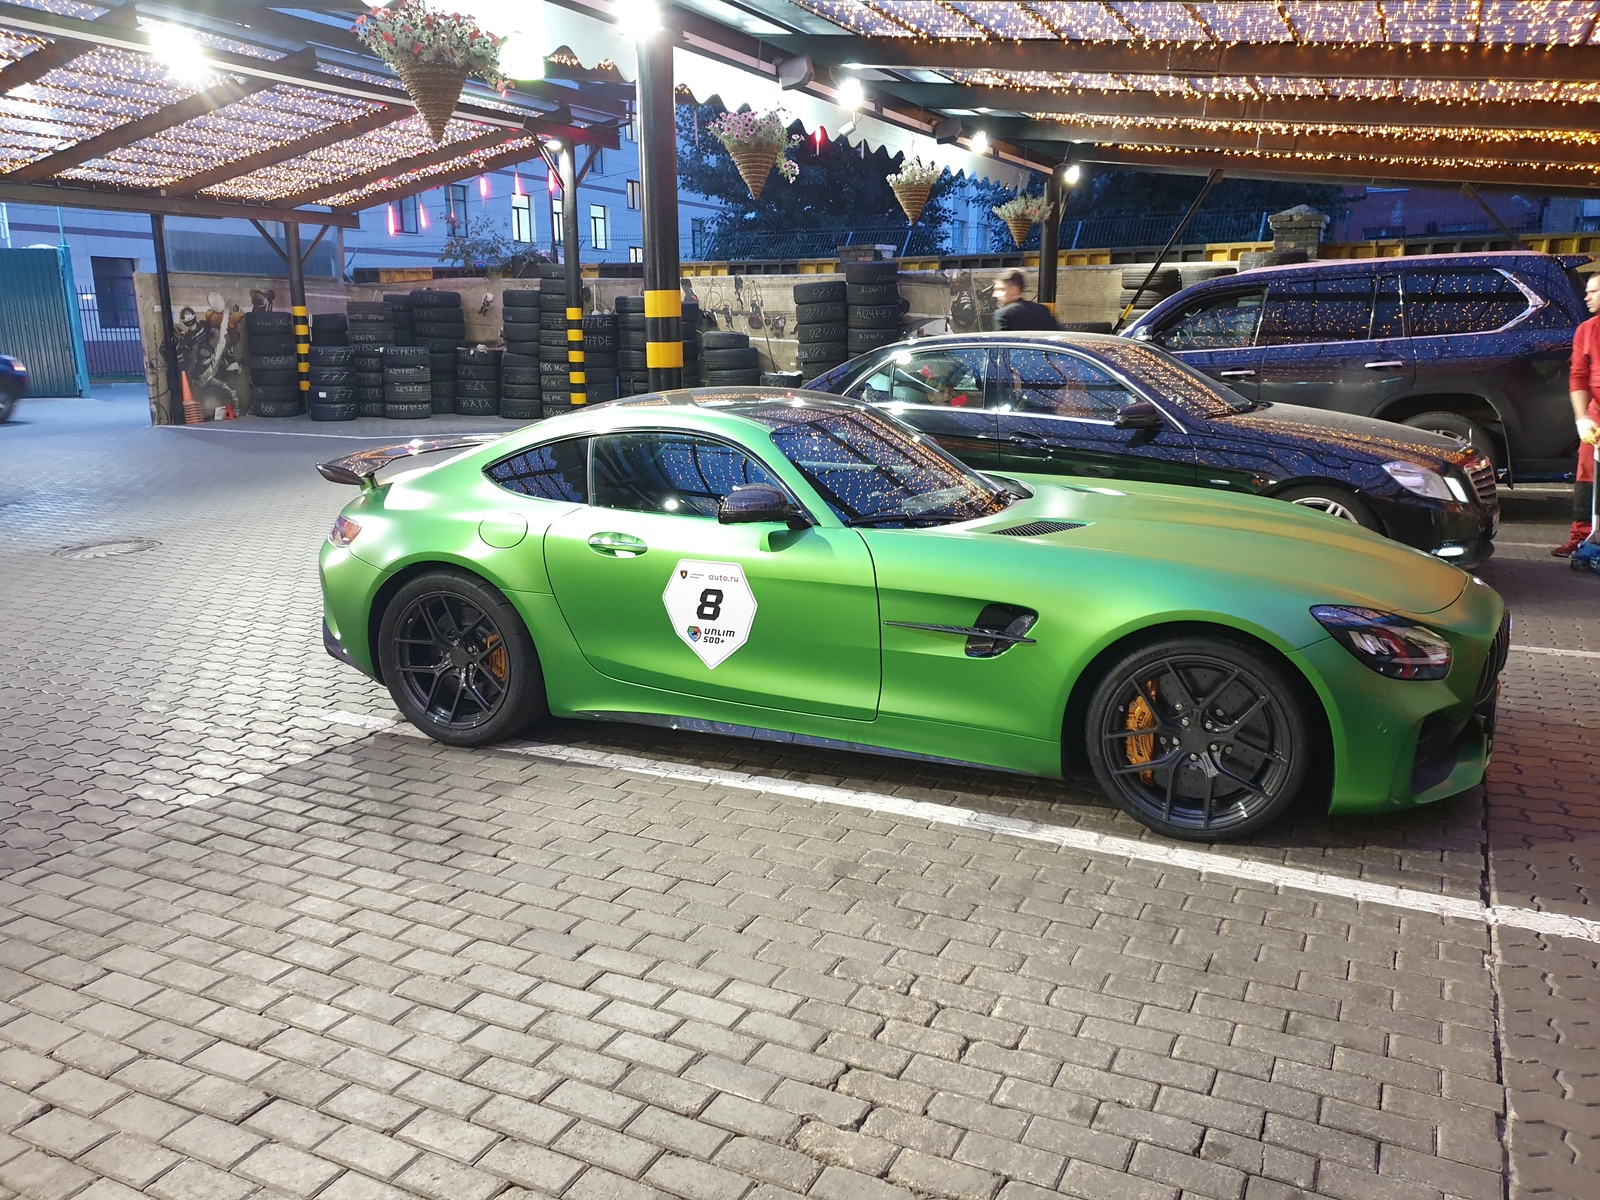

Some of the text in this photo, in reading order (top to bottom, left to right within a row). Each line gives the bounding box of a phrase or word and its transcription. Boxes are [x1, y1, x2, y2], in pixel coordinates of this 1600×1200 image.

[708, 574, 739, 582] auto.ru
[696, 588, 724, 621] 8
[704, 628, 735, 637] UNLIM
[703, 636, 725, 644] 500+
